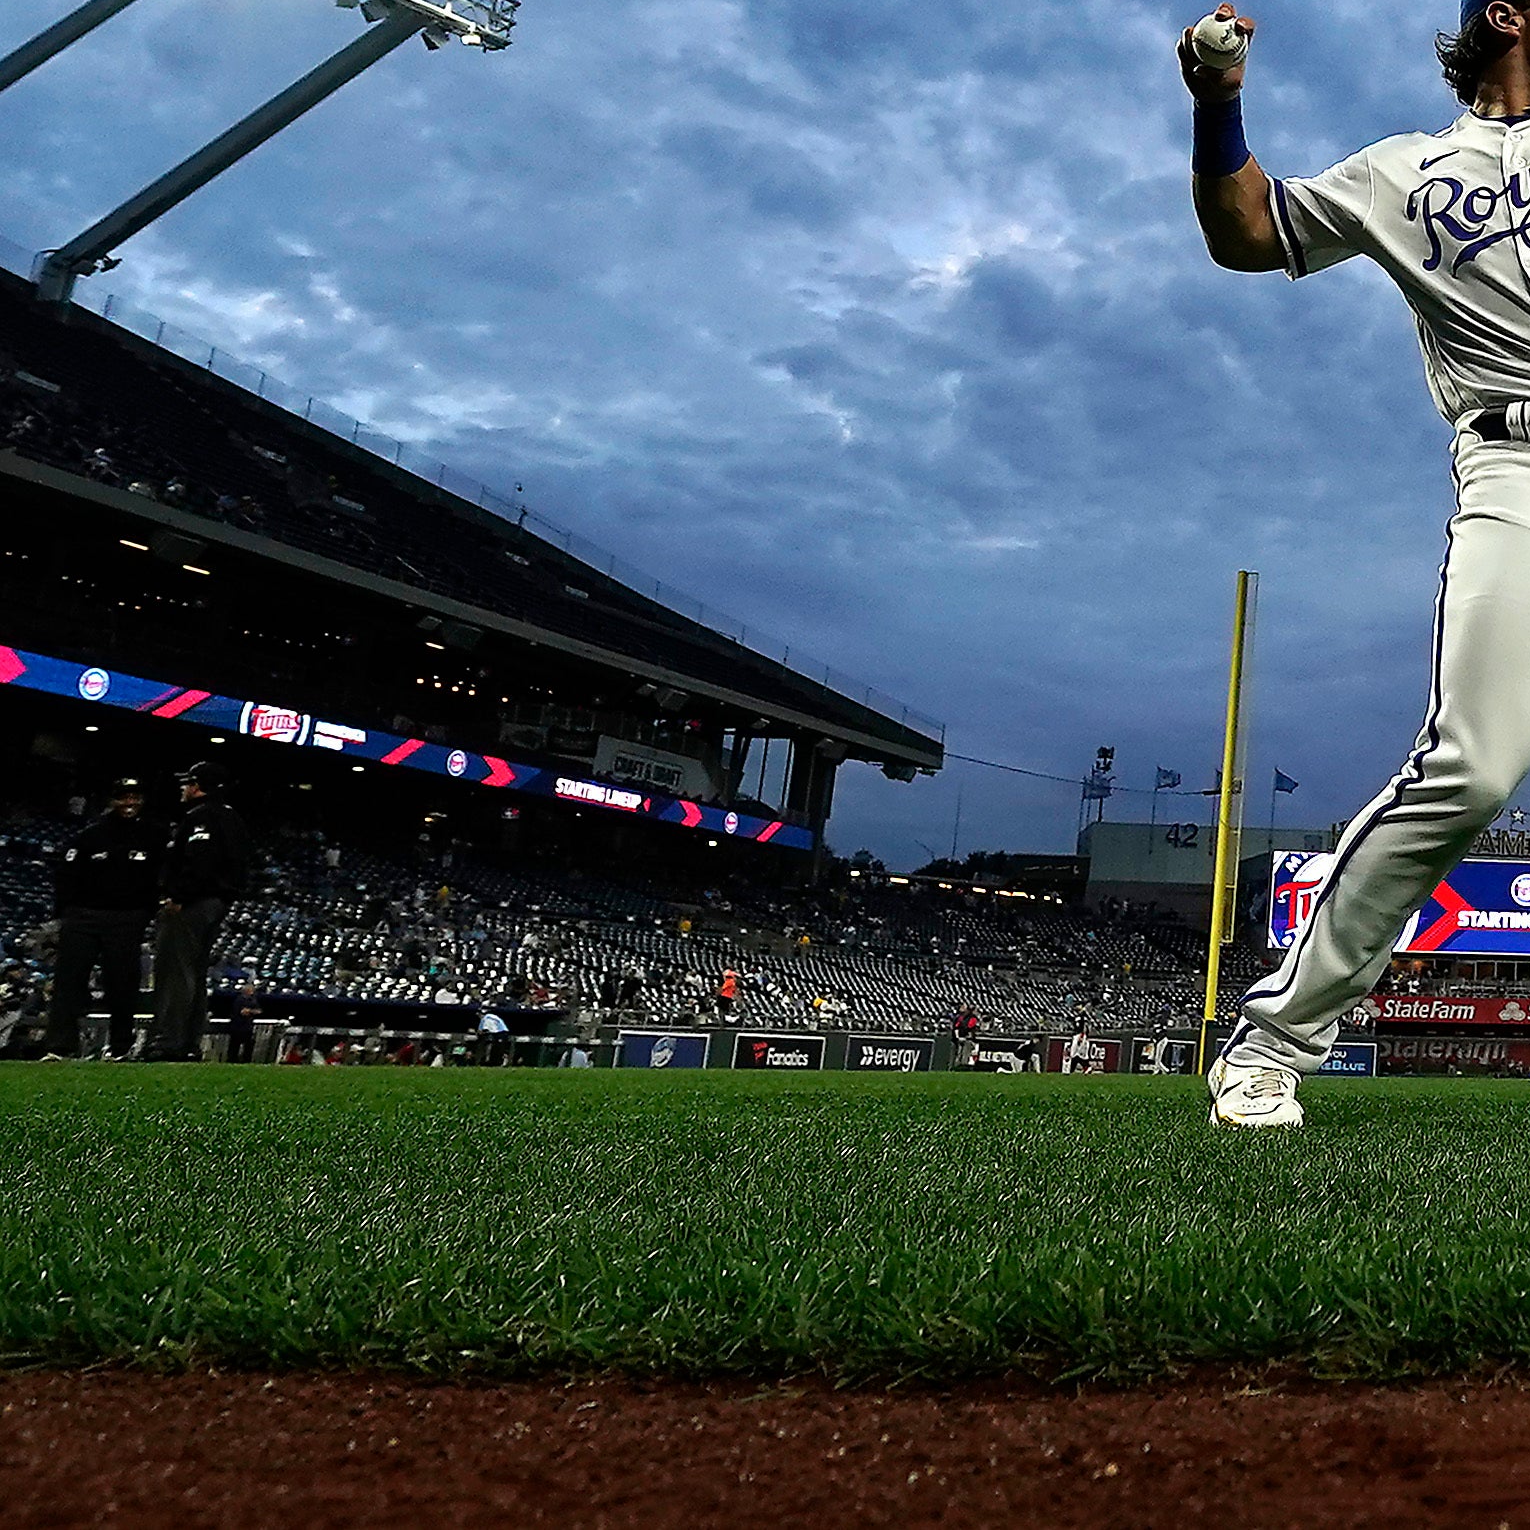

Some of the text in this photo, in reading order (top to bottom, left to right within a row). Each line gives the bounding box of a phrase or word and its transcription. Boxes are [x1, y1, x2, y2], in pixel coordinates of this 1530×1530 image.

[555, 776, 604, 804] STARTING
[1382, 999, 1475, 1020] StateFarm
[766, 1047, 809, 1067] Fanatics
[874, 1047, 921, 1073] evergy
